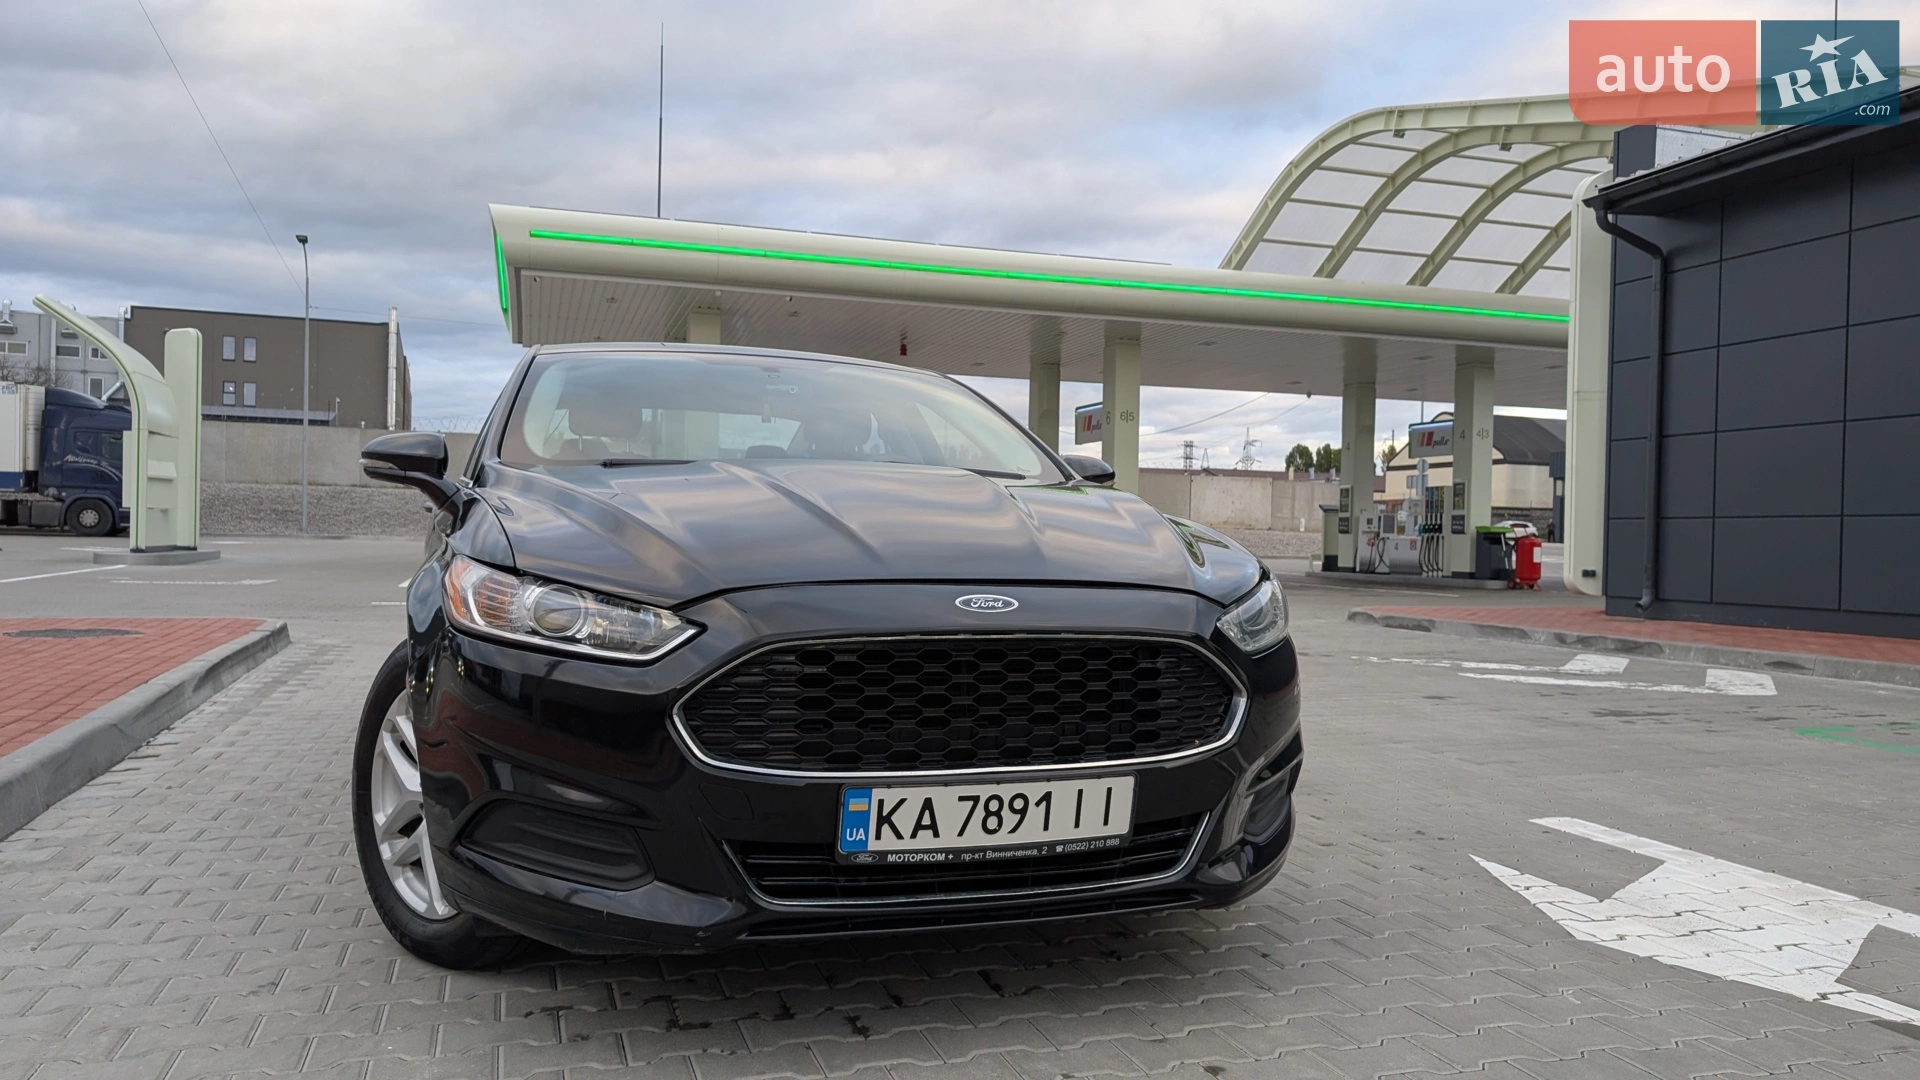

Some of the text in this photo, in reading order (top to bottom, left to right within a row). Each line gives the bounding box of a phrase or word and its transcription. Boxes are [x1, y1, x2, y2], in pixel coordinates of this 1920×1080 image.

[1105, 411, 1111, 425] 6
[1459, 429, 1466, 440] 4
[971, 598, 1004, 608] Ford
[874, 797, 940, 841] KA
[956, 791, 1053, 837] 7891
[846, 828, 866, 841] UA
[887, 852, 946, 863] МОТОРКОМ
[961, 852, 985, 861] пр-кт
[1041, 846, 1048, 854] 2
[1064, 841, 1089, 853] (0522)
[1090, 839, 1105, 849] 210
[1105, 837, 1120, 847] 888
